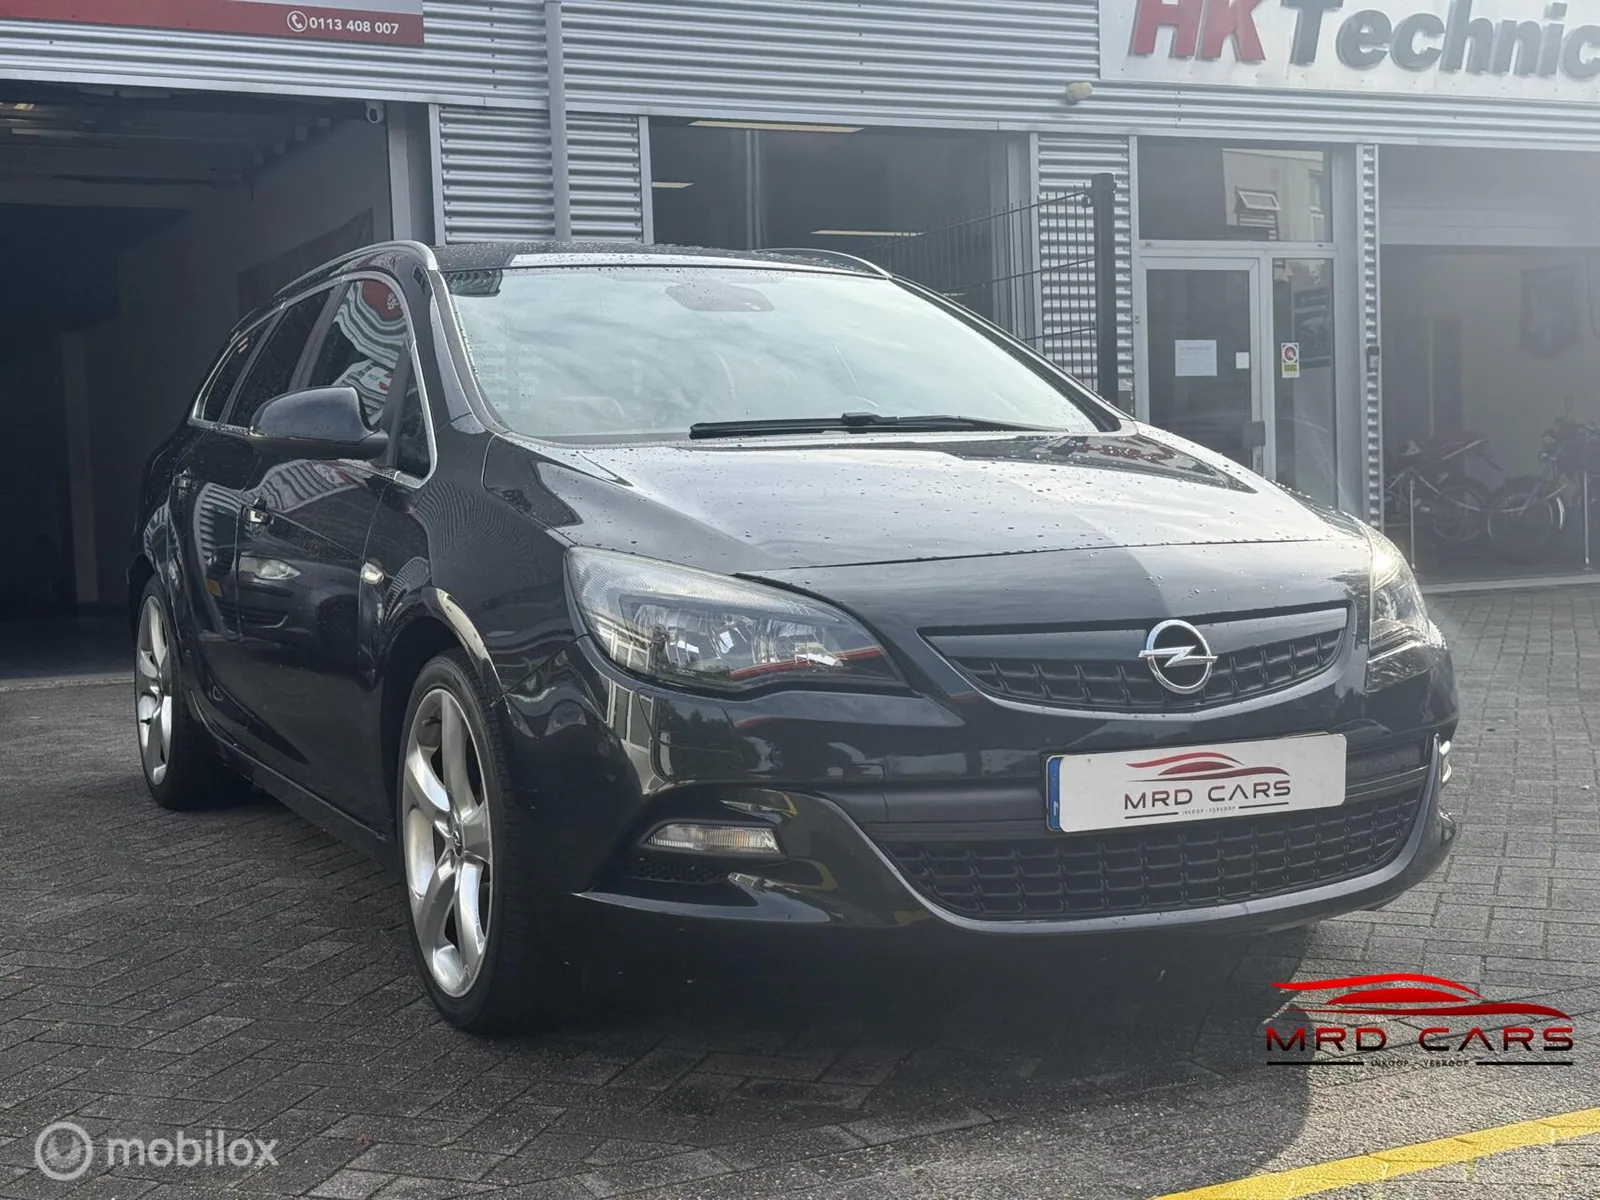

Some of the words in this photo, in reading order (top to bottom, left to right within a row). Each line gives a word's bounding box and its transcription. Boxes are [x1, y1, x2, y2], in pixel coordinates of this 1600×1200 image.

[309, 17, 342, 30] 0113
[346, 20, 371, 32] 408
[375, 22, 399, 34] 007
[1128, 0, 1266, 62] HK
[1124, 788, 1193, 809] MRD
[1208, 779, 1291, 802] CARS
